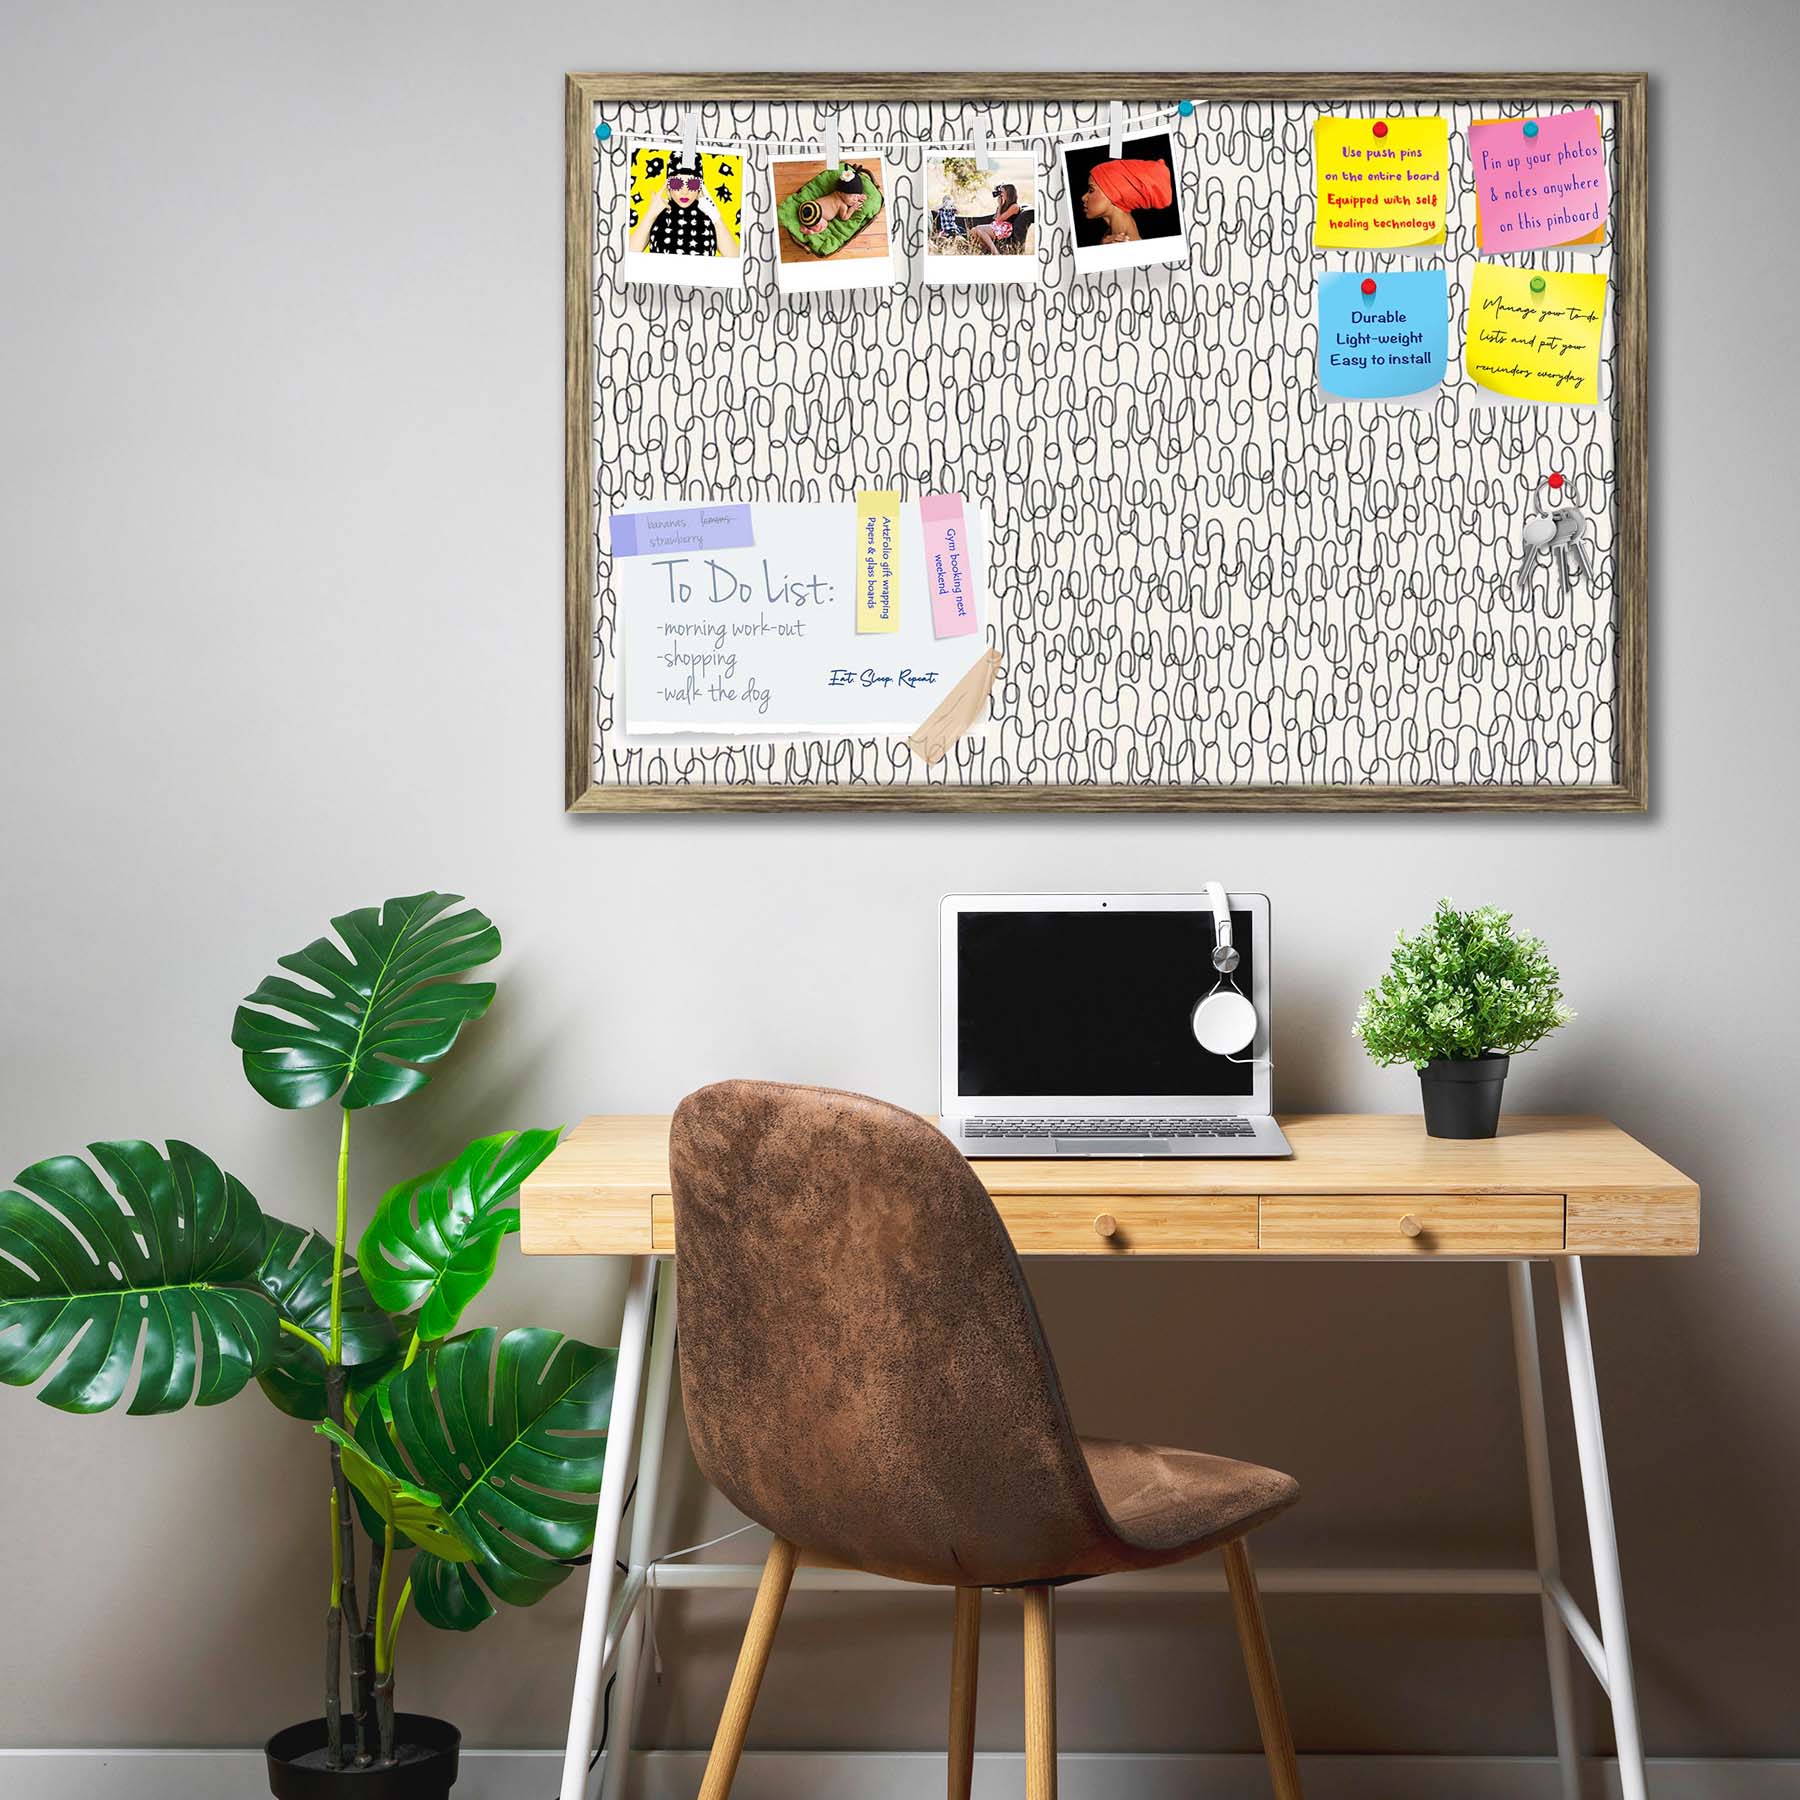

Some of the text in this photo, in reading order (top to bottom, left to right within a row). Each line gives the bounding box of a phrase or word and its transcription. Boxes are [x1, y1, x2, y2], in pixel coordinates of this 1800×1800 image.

[1342, 146, 1423, 162] Use push pins
[1482, 140, 1598, 172] Pin up your photos
[1325, 170, 1440, 182] on the entire board
[1490, 173, 1599, 202] & notes anywhere
[1327, 193, 1438, 208] Equipped with self
[1329, 218, 1436, 231] healing technology
[1500, 202, 1599, 232] on this pinboard
[1351, 310, 1407, 324] Durable
[1482, 295, 1537, 320] Manage
[1539, 309, 1566, 323] your
[1336, 331, 1424, 348] Light-weight
[1511, 335, 1537, 348] and
[1537, 336, 1563, 353] put
[1559, 344, 1587, 356] your
[1330, 351, 1432, 369] Easy to install
[1475, 364, 1585, 389] reminders everyday
[649, 530, 704, 550] strawberry
[865, 516, 877, 609] Papers & glass boards
[880, 516, 893, 620] ArtzFolio gift wrapping
[934, 553, 950, 595] weekend
[945, 528, 967, 617] Gym booking next
[652, 558, 834, 607] To Do List:
[657, 611, 807, 650] -morning work-out
[657, 639, 738, 679] -shopping
[657, 675, 772, 714] -walk the dog
